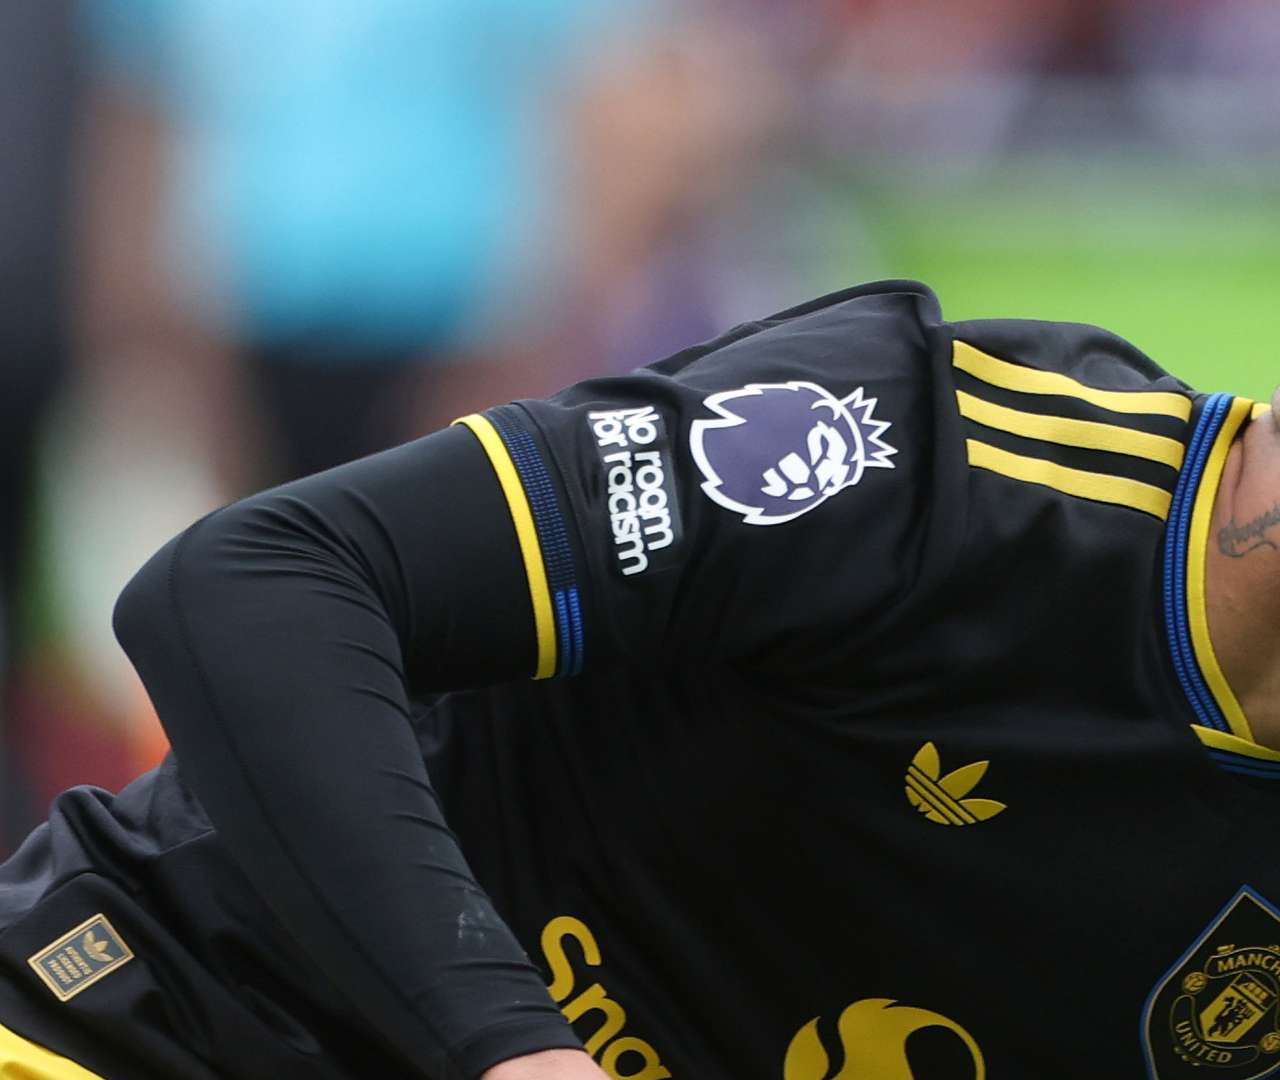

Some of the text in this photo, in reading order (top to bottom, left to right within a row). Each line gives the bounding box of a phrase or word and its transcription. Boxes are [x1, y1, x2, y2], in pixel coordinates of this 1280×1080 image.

[587, 409, 650, 577] for racism
[620, 405, 675, 551] No room
[1175, 1019, 1233, 1064] UNITED
